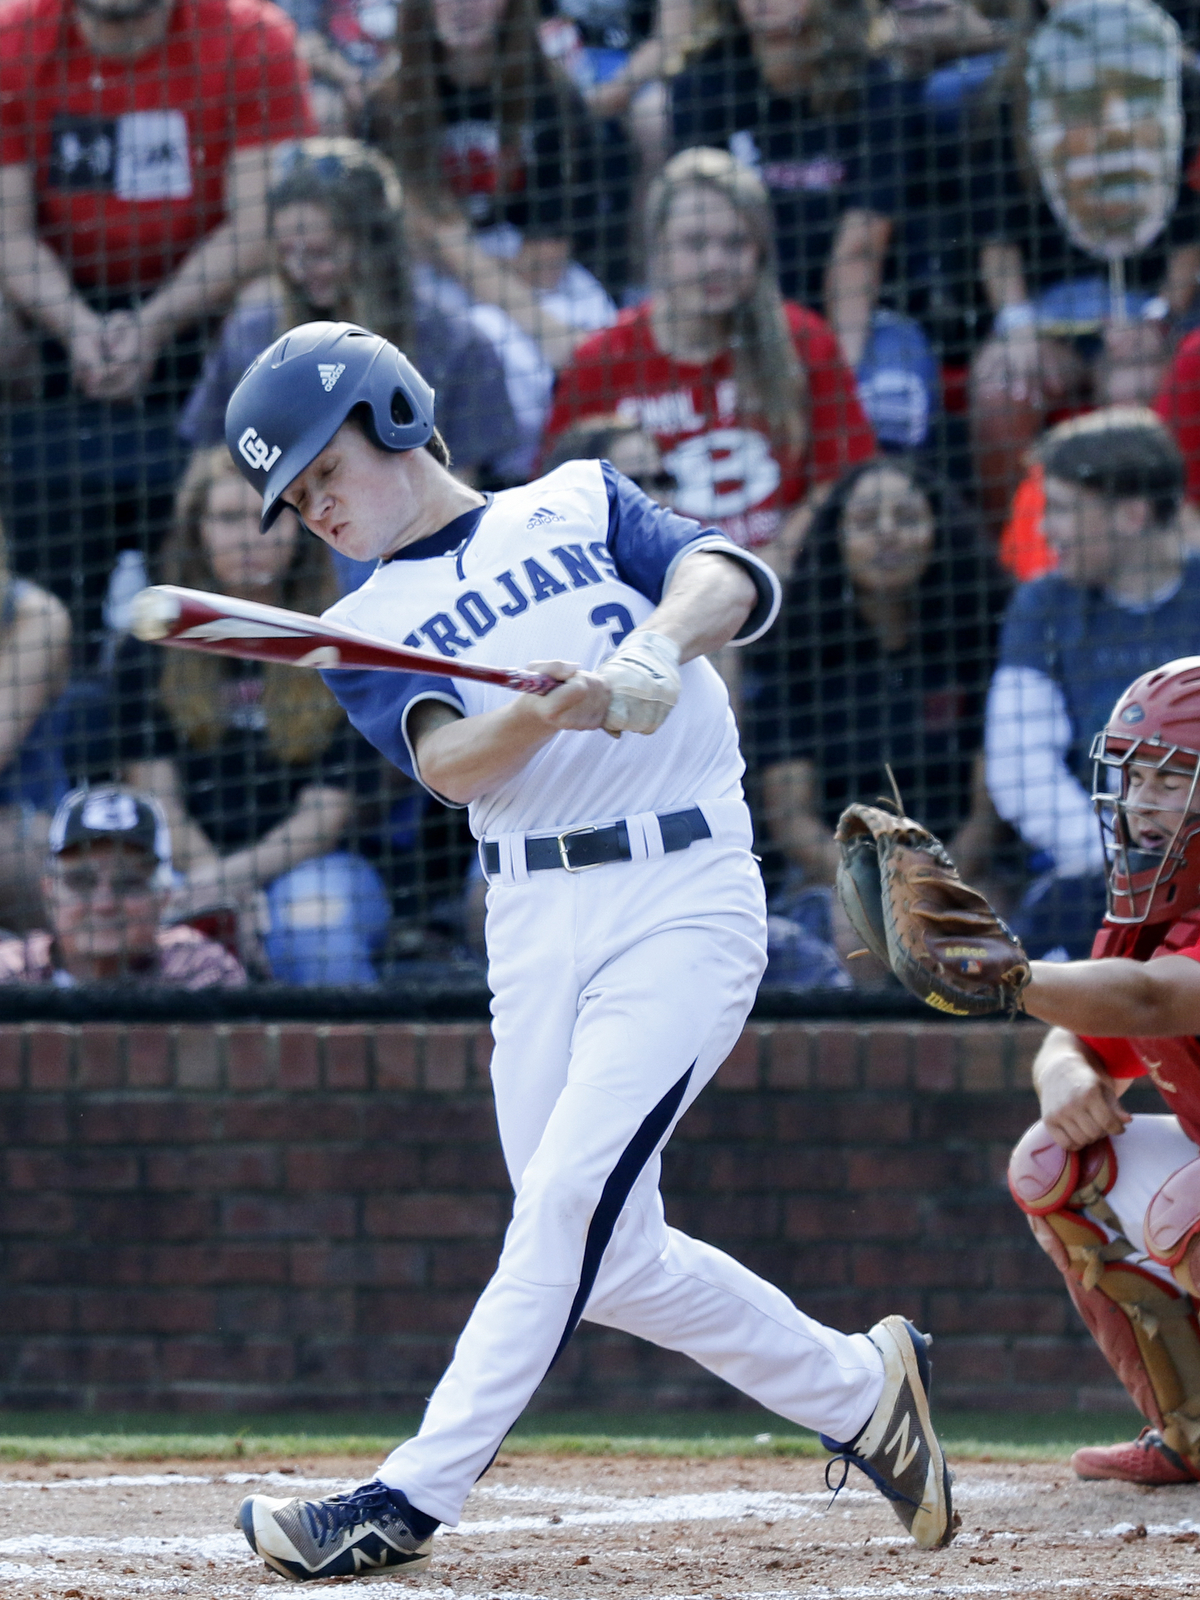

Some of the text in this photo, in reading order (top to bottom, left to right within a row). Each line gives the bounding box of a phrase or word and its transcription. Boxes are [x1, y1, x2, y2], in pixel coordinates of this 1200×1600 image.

[402, 541, 623, 657] ROJANS
[884, 1411, 920, 1479] N
[351, 1547, 387, 1572] N
